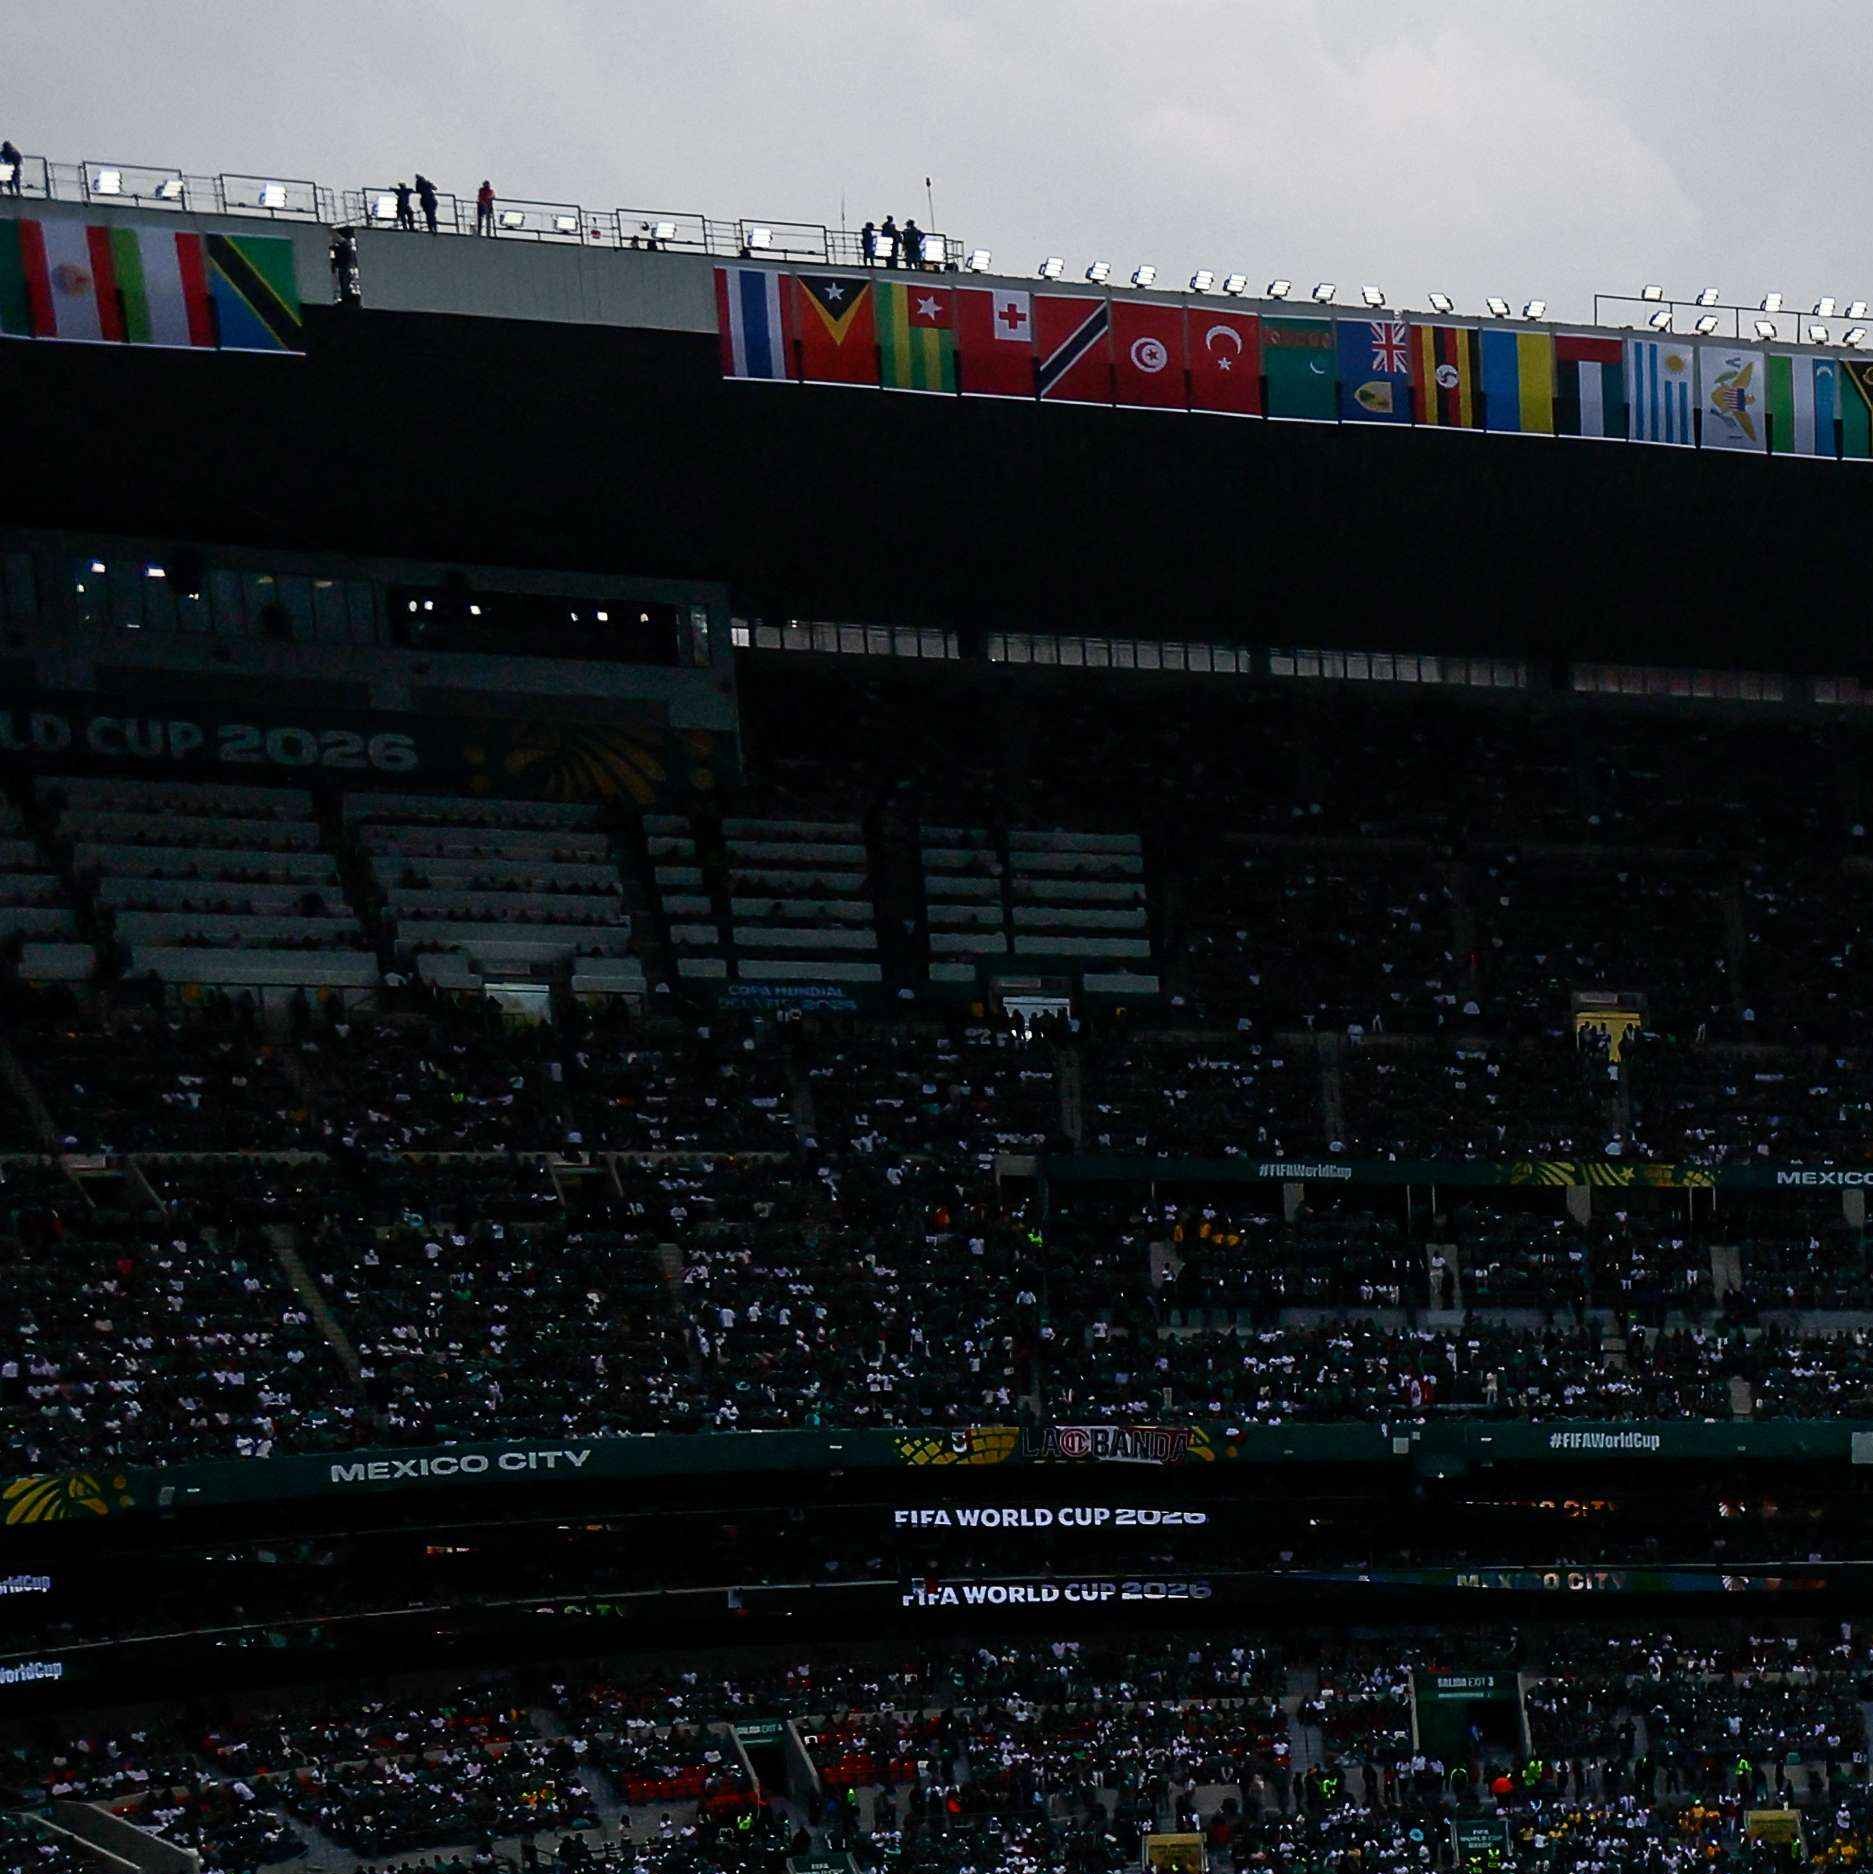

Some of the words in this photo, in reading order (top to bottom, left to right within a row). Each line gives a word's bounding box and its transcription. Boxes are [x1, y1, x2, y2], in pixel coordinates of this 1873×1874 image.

[86, 714, 206, 761] CUP
[217, 723, 420, 773] 2026
[1091, 1428, 1189, 1460] BANDA
[1548, 1431, 1661, 1452] #FIFAWorldCup
[329, 1454, 490, 1483] MEXICO
[498, 1449, 592, 1471] CITY
[894, 1509, 952, 1528] FIFA
[955, 1508, 1053, 1527] WORLD
[1058, 1507, 1111, 1526] CUP
[1114, 1508, 1208, 1526] 2026
[961, 1585, 1061, 1607] WORLD
[1064, 1583, 1116, 1603] CUP
[1120, 1580, 1215, 1601] 2026
